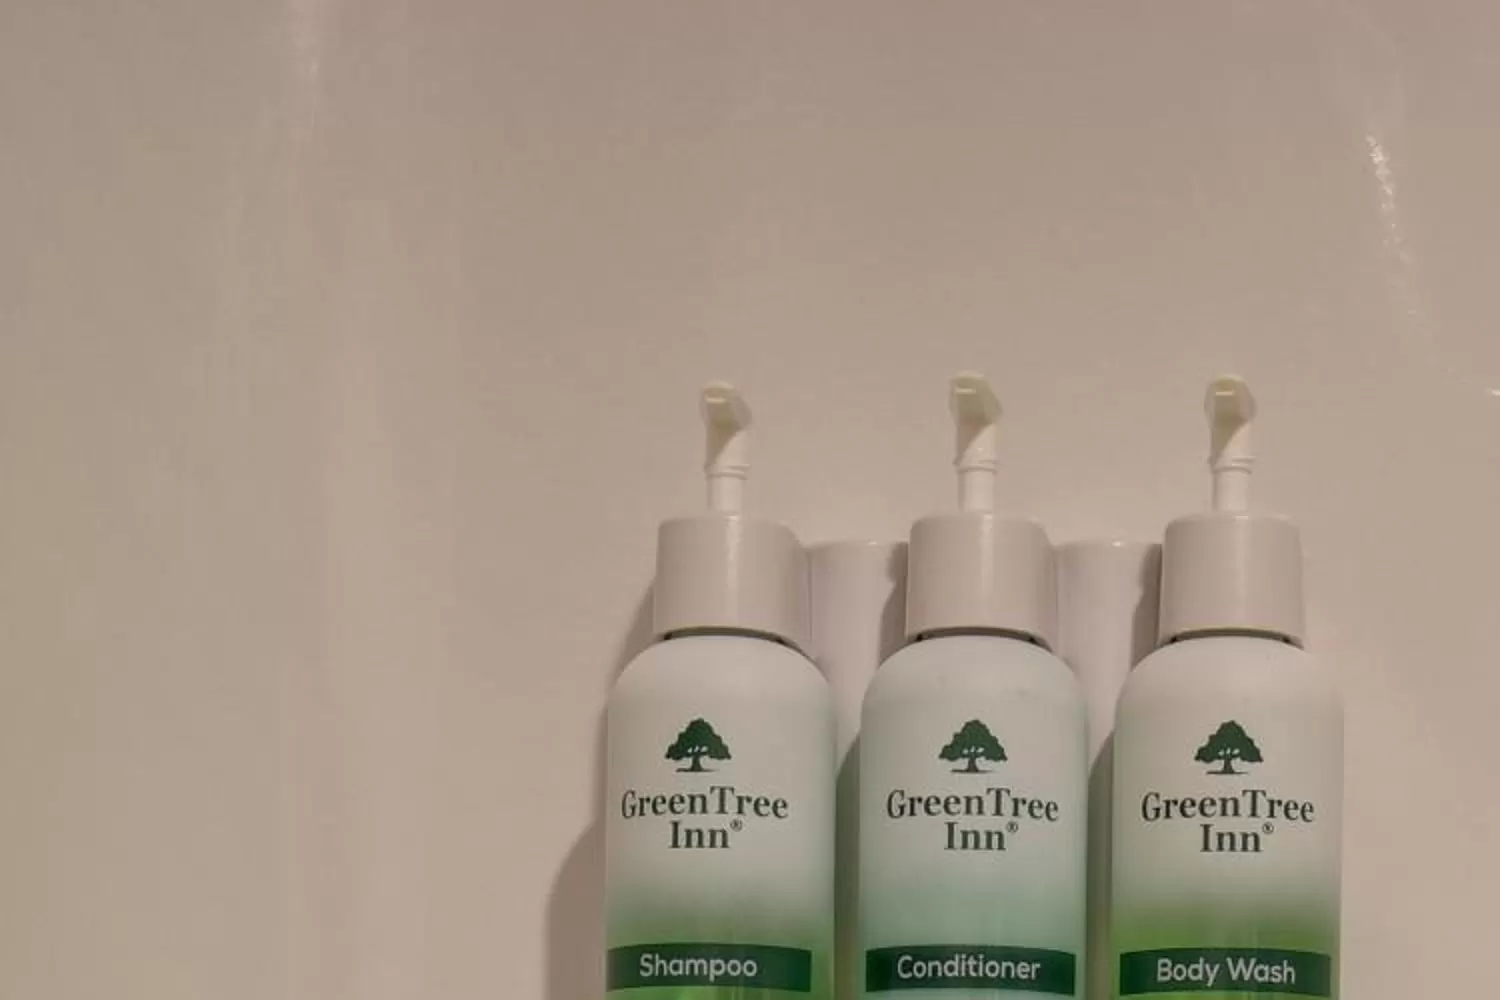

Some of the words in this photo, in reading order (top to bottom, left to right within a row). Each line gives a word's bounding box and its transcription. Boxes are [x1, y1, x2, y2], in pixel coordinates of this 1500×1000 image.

[621, 785, 789, 819] GreenTree
[886, 787, 1060, 822] GreenTree
[1141, 789, 1315, 823] GreenTree
[638, 953, 759, 983] Shampoo
[896, 953, 1042, 980] Conditioner
[1156, 956, 1220, 988] Body
[1226, 957, 1296, 985] Wash
